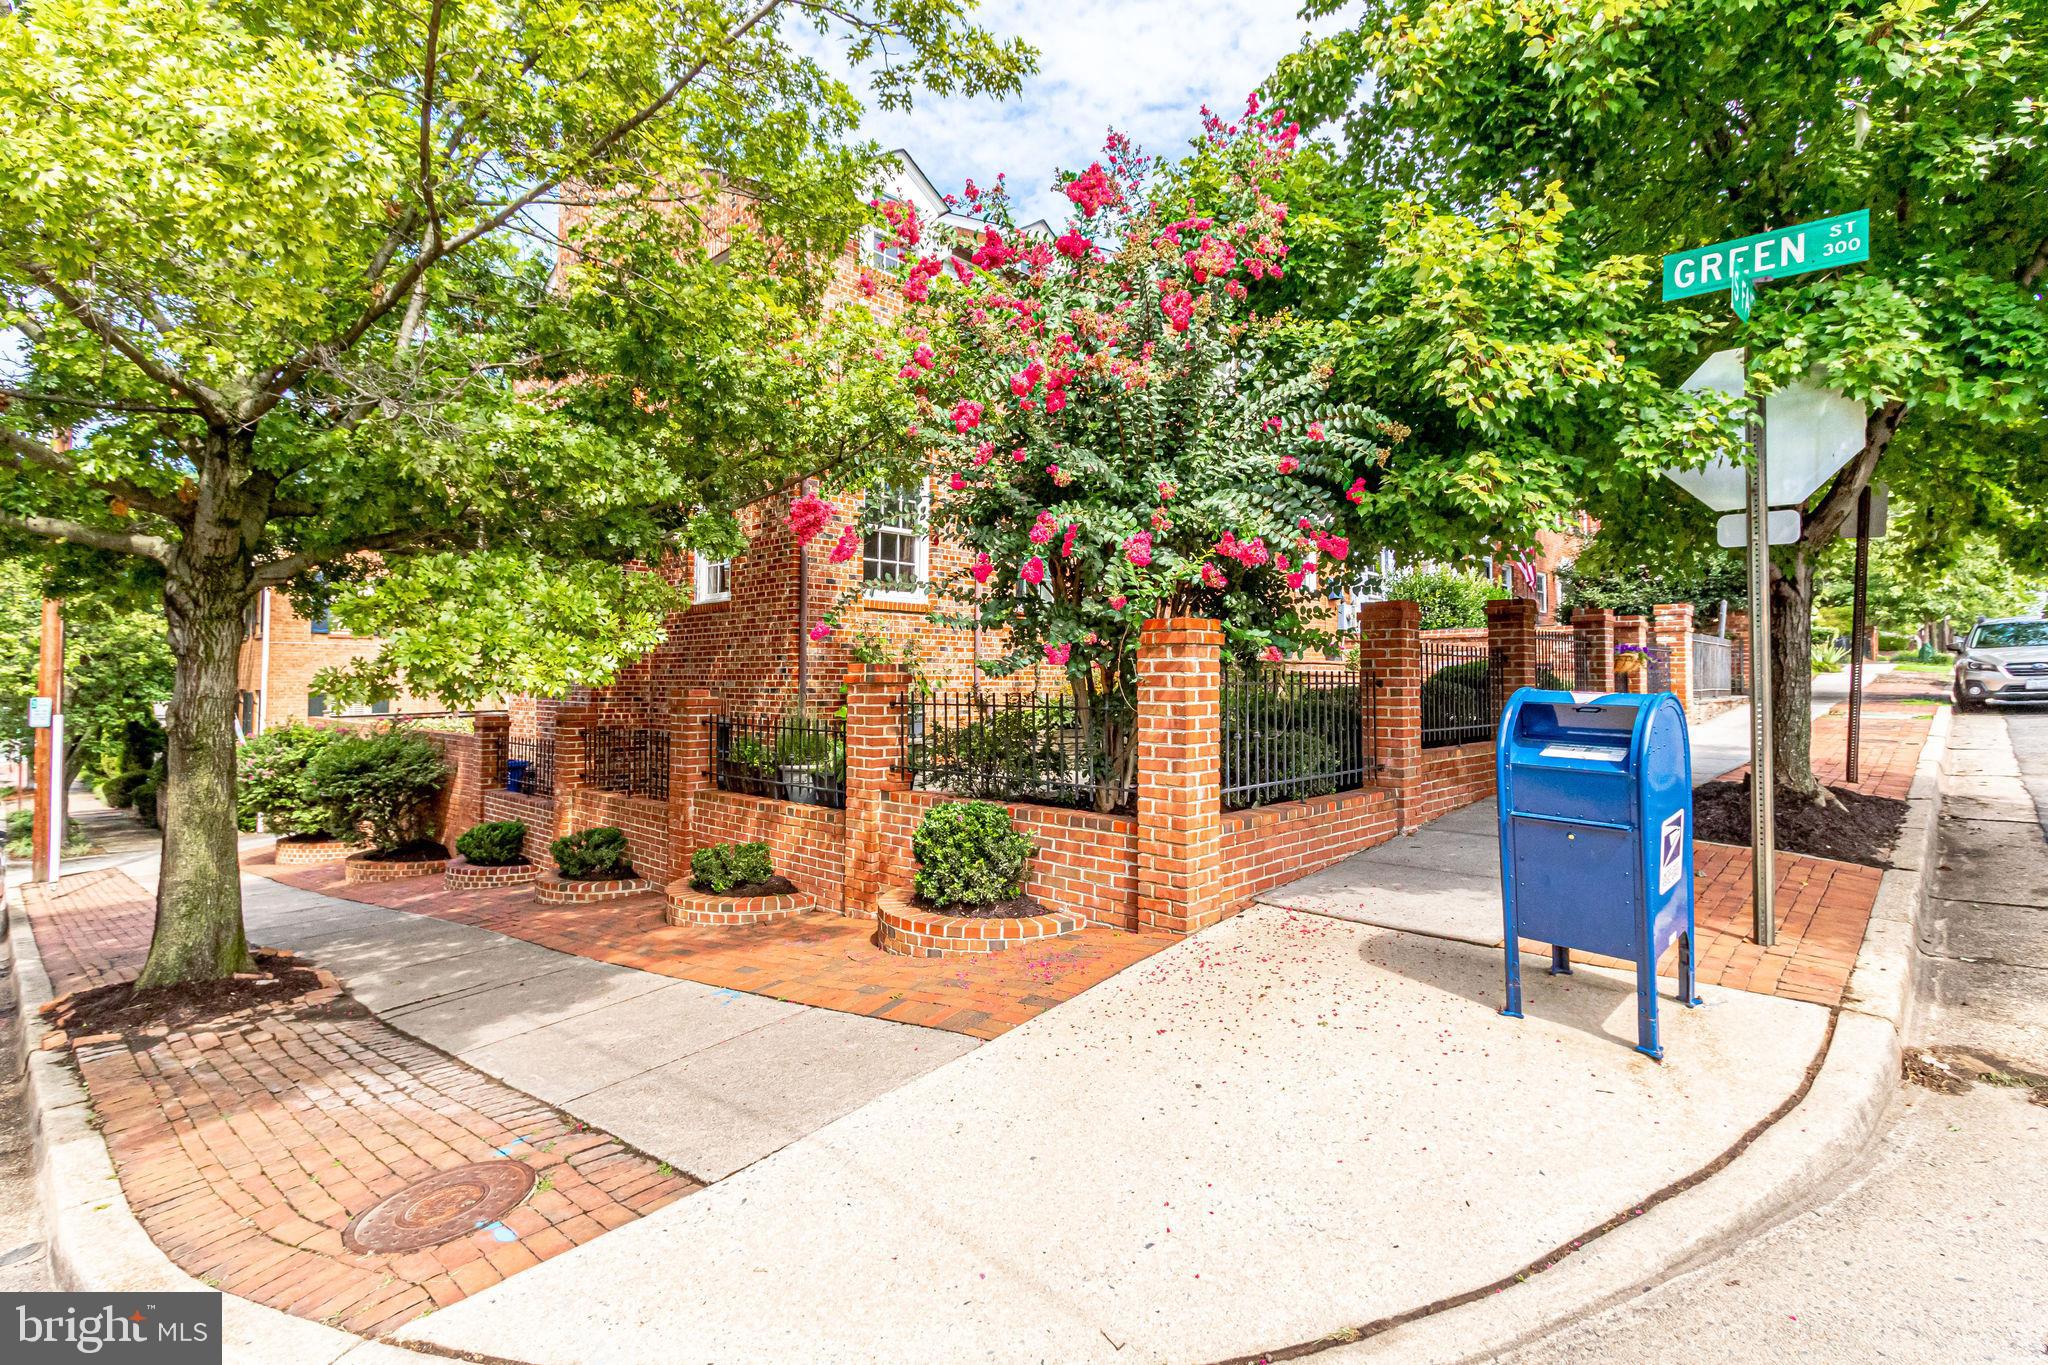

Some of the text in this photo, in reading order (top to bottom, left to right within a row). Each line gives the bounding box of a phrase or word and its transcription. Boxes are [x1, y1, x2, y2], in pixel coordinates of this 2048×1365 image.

[1674, 220, 1856, 288] GREEN ST
[1823, 237, 1861, 257] 300
